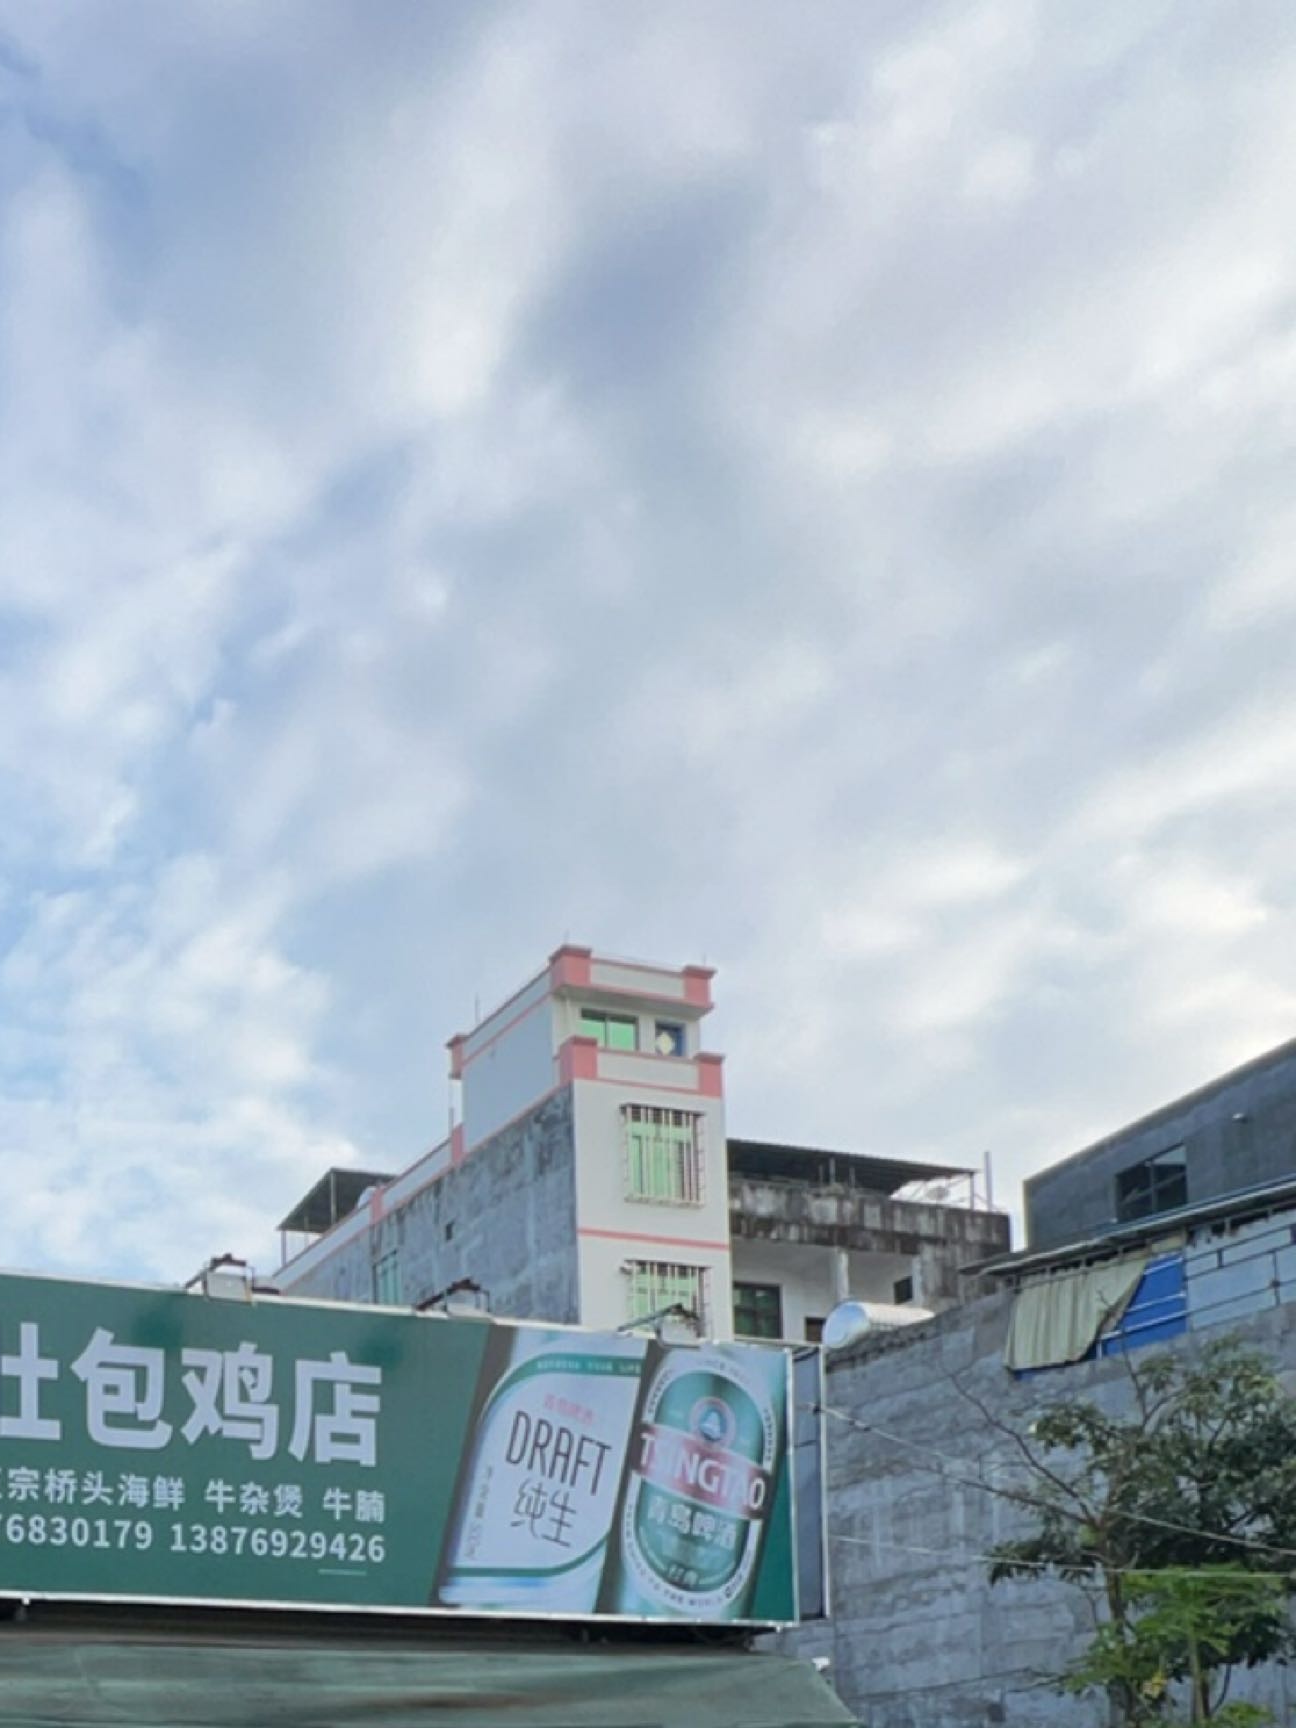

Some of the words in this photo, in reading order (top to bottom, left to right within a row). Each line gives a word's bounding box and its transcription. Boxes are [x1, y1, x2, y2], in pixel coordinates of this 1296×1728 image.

[505, 1410, 613, 1497] DRAFT
[640, 1432, 767, 1512] TNGTAO
[203, 1479, 304, 1519] 牛杂煲
[510, 1477, 577, 1549] 纯生
[170, 1523, 386, 1564] 13876929426
